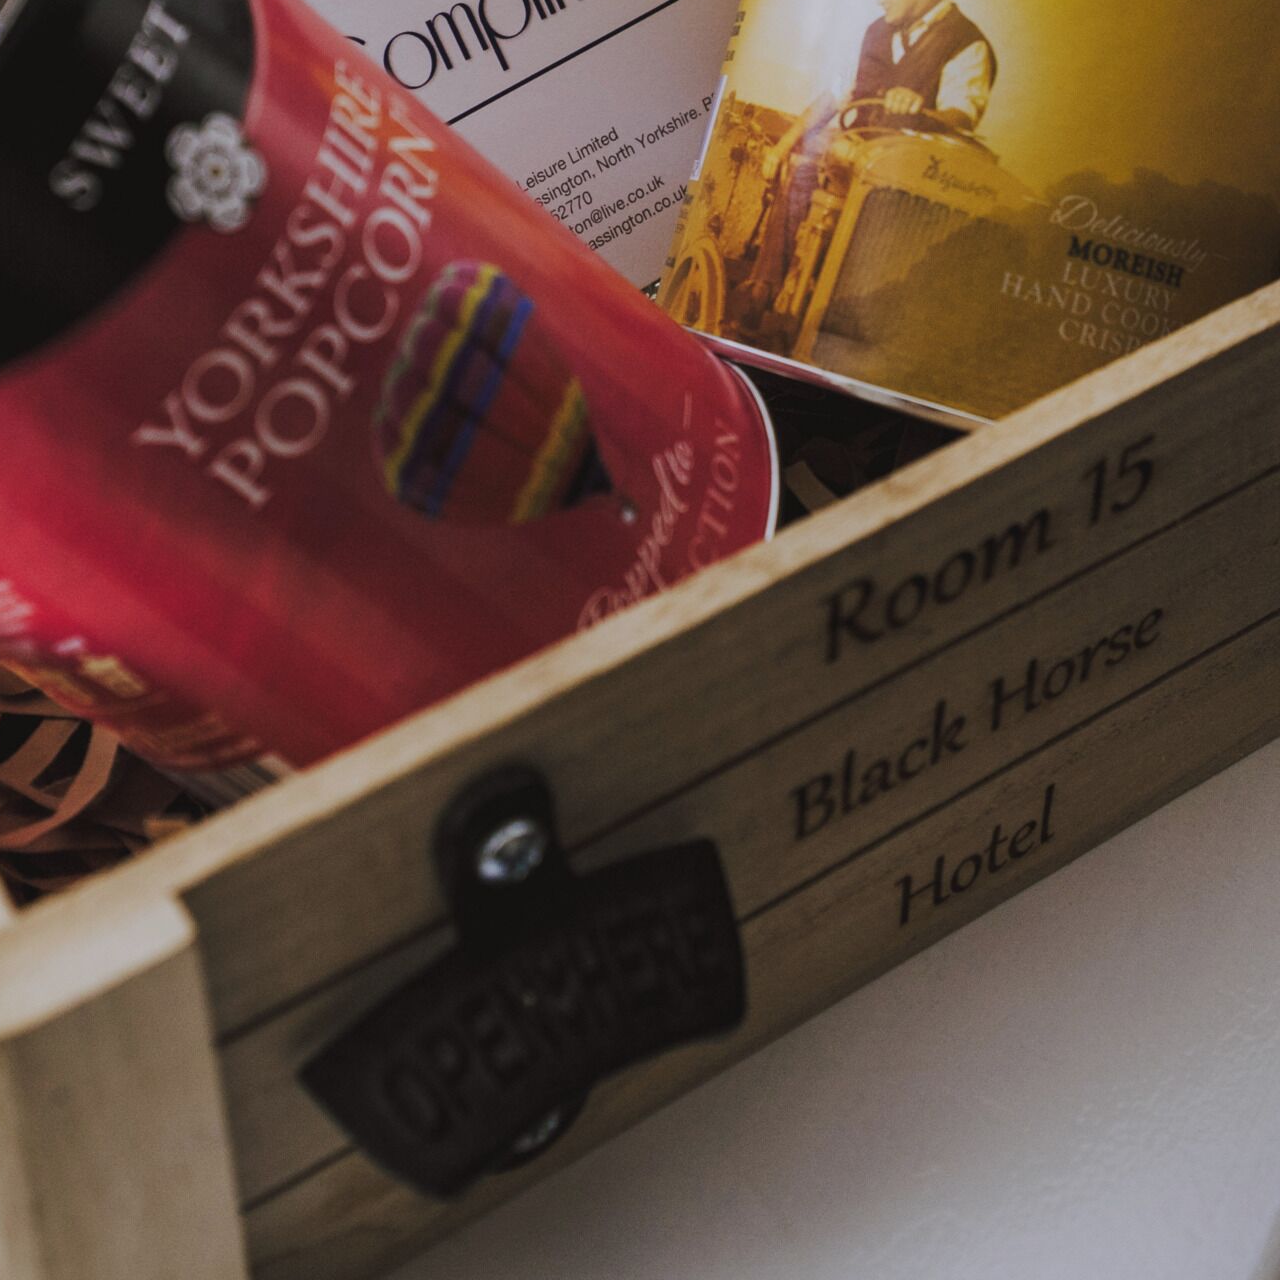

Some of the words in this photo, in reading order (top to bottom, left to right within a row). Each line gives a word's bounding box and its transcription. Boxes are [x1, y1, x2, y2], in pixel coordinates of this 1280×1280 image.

[567, 127, 619, 165] Limited
[596, 144, 636, 173] North
[635, 107, 702, 149] Yorkshire.
[131, 60, 383, 456] YORKSHIRE
[1049, 195, 1207, 267] Deliciously
[1067, 234, 1185, 288] MOREISH
[1001, 271, 1092, 316] HAND
[1063, 261, 1177, 312] LUXURY
[824, 507, 1054, 665] Room
[1083, 433, 1155, 527] 15
[788, 699, 967, 842] Black
[990, 607, 1164, 731] Horse
[895, 782, 1055, 927] Hotel
